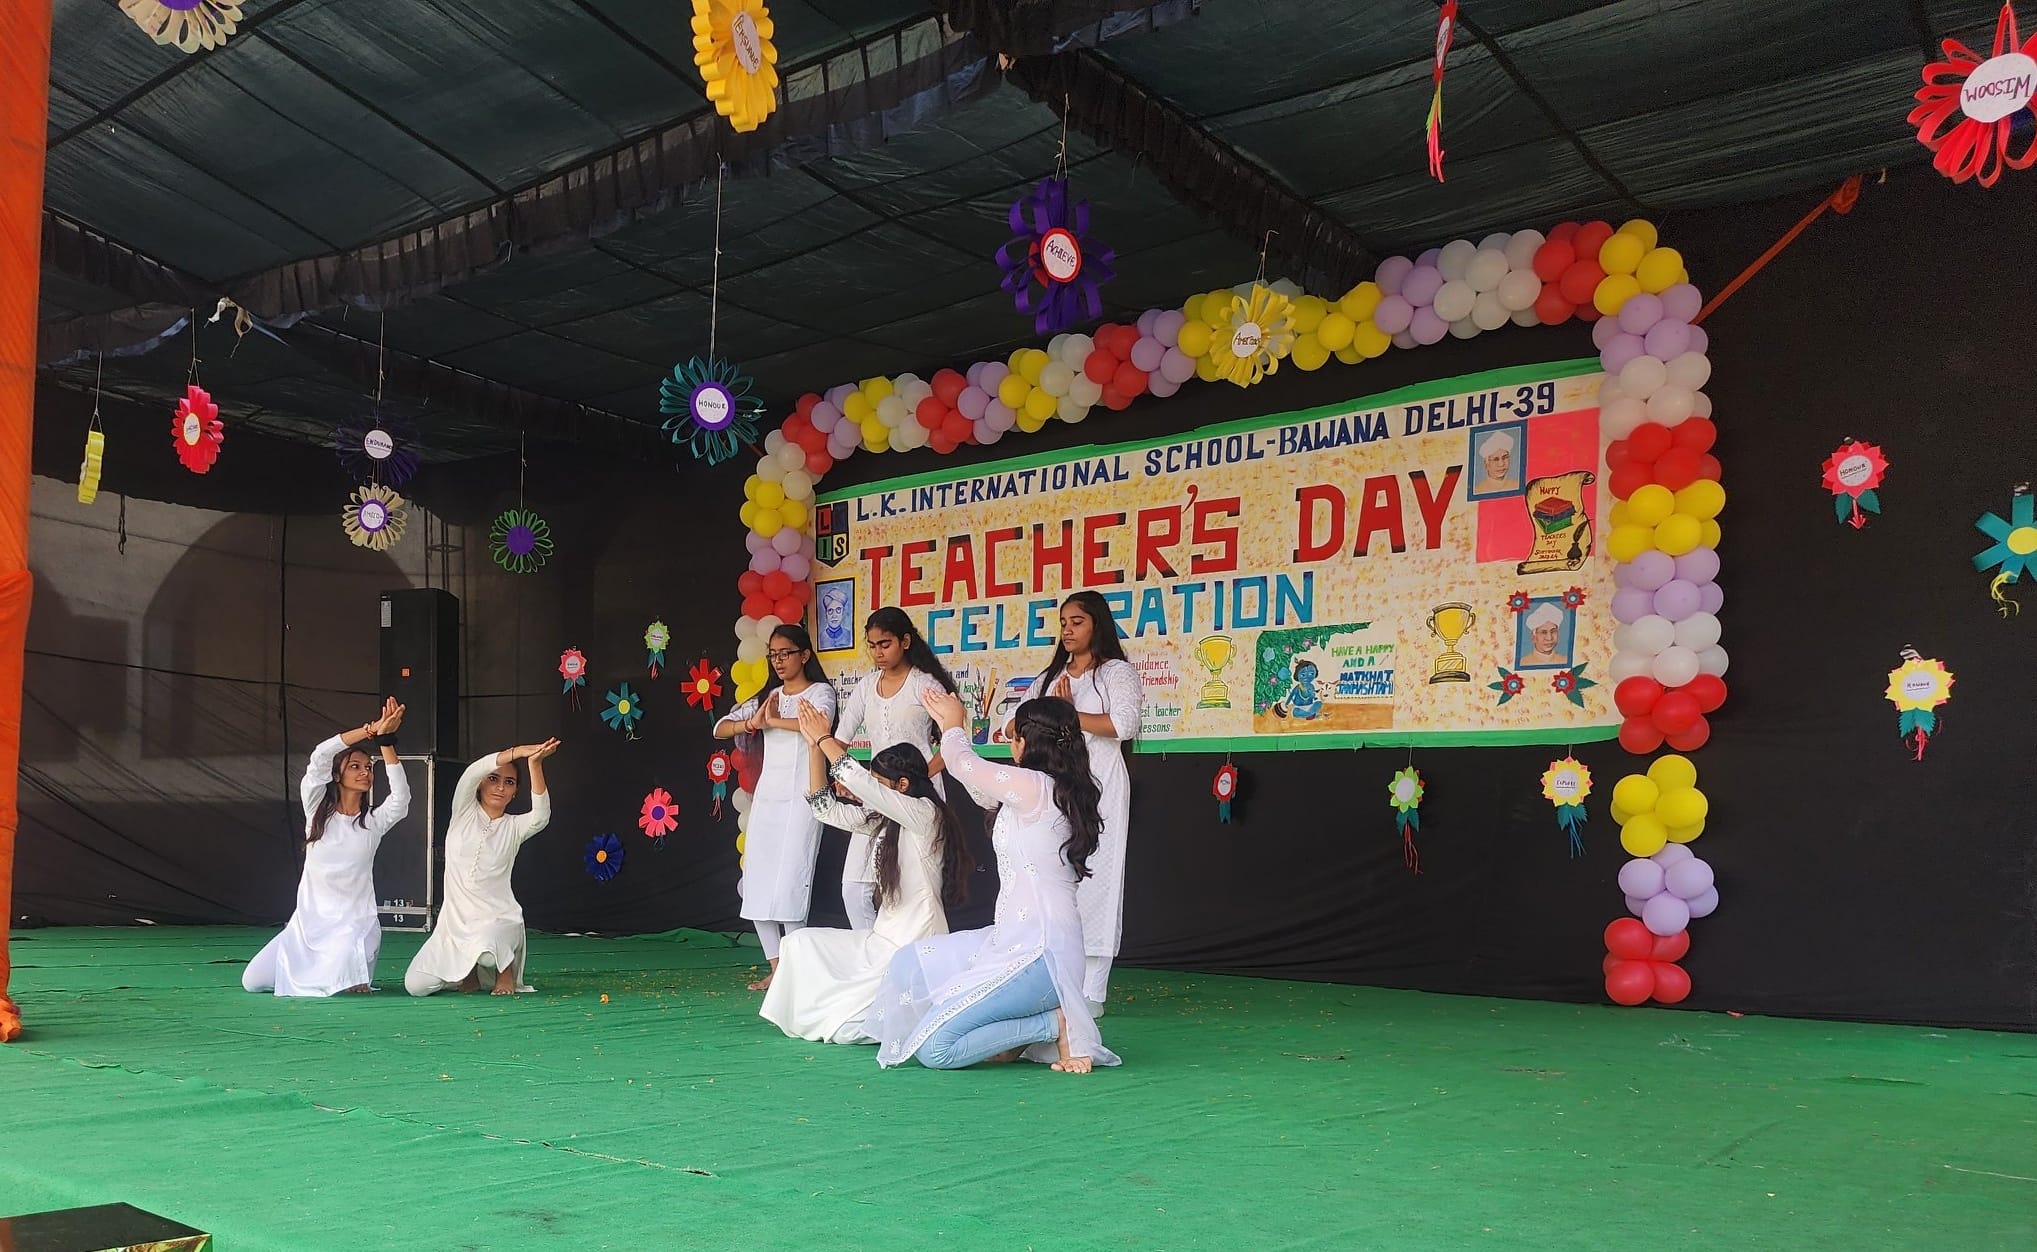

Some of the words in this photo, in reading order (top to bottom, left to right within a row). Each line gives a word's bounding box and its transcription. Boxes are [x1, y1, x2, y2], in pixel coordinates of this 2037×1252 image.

[1963, 73, 2032, 102] WISDOM
[1046, 239, 1077, 268] ACHIEVE
[1539, 486, 1560, 495] HAPPY
[860, 484, 1241, 611] TEACHER'S
[1293, 465, 1464, 564] DAY
[927, 571, 1314, 655] CELERATION
[1331, 646, 1354, 657] HAVE
[1355, 646, 1362, 655] A
[1366, 644, 1394, 654] HAPPY
[1342, 657, 1365, 668] AND
[1367, 656, 1375, 666] A
[956, 662, 969, 678] and
[1141, 670, 1180, 689] friendship
[1154, 702, 1181, 717] teacher
[393, 899, 405, 907] 13
[393, 914, 404, 922] 13
